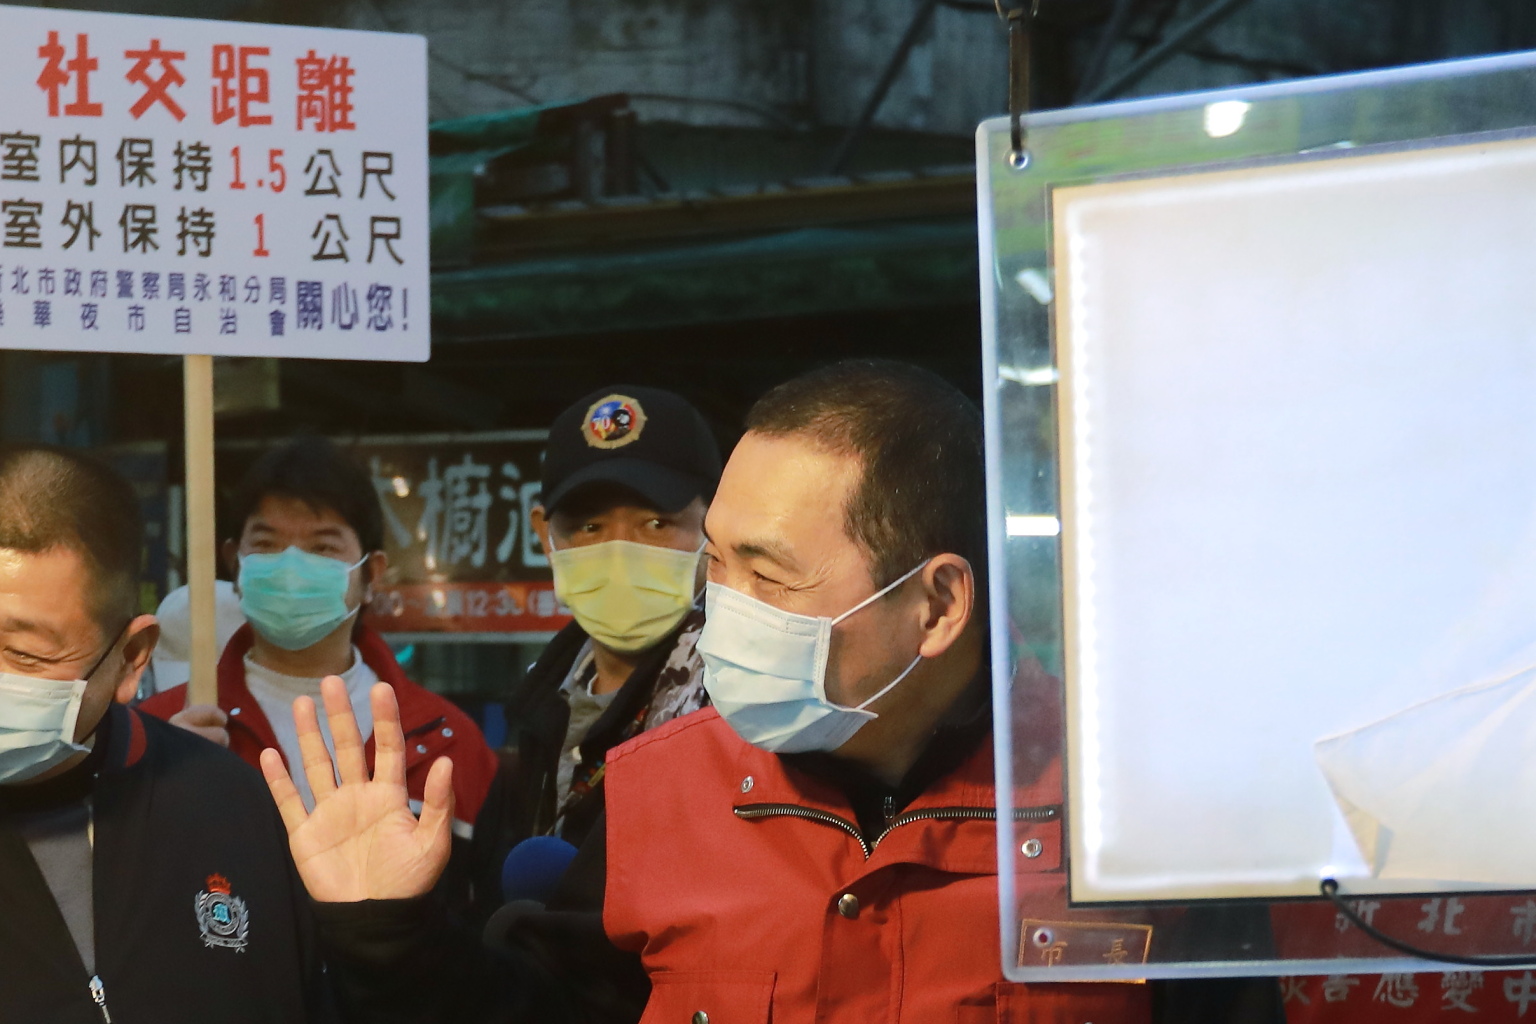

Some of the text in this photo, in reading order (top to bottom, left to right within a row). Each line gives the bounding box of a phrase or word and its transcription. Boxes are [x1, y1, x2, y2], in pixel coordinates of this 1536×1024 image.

[35, 30, 357, 133] 社交距離
[295, 279, 409, 332] 關心您!
